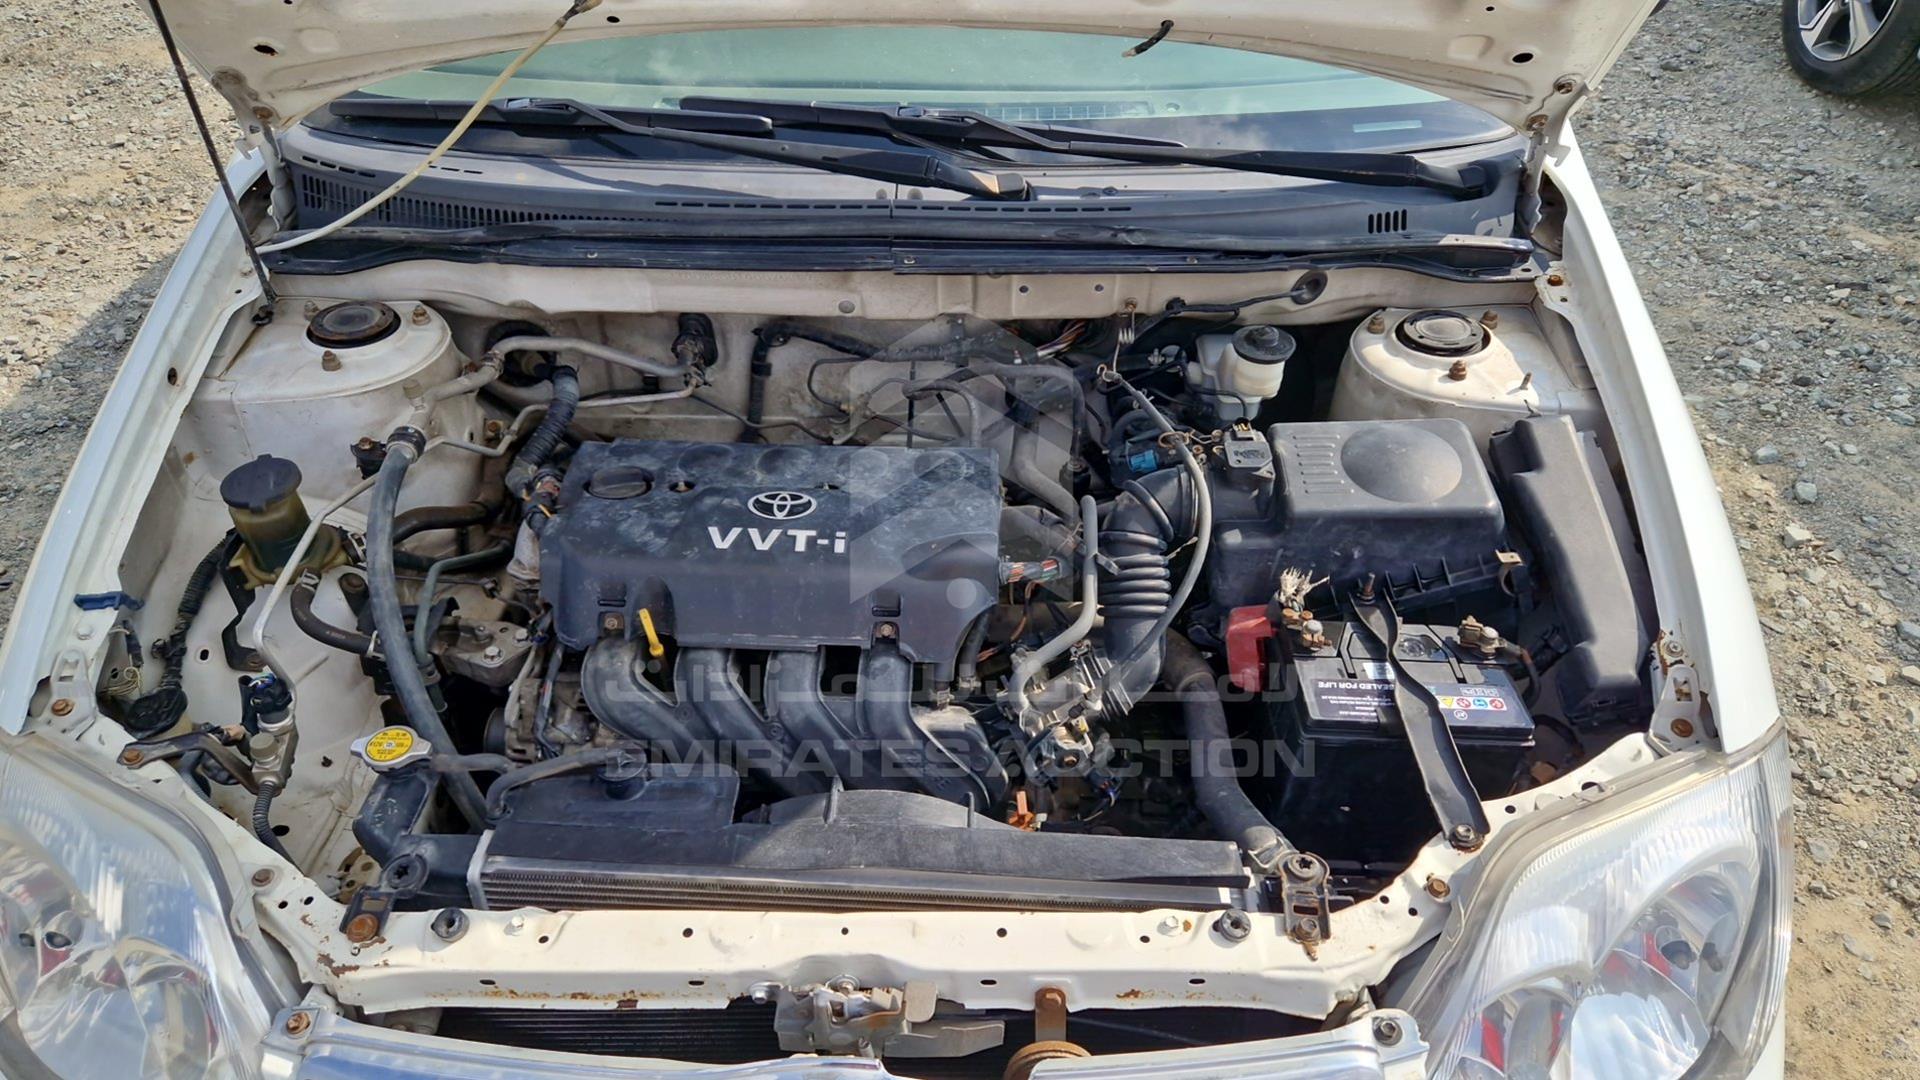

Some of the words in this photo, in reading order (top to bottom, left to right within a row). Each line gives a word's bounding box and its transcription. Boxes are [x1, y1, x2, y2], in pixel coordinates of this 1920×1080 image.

[708, 526, 846, 553] VVT-i
[1318, 681, 1337, 689] LIFE
[1339, 682, 1358, 690] FOR
[1359, 682, 1395, 691] SEALED
